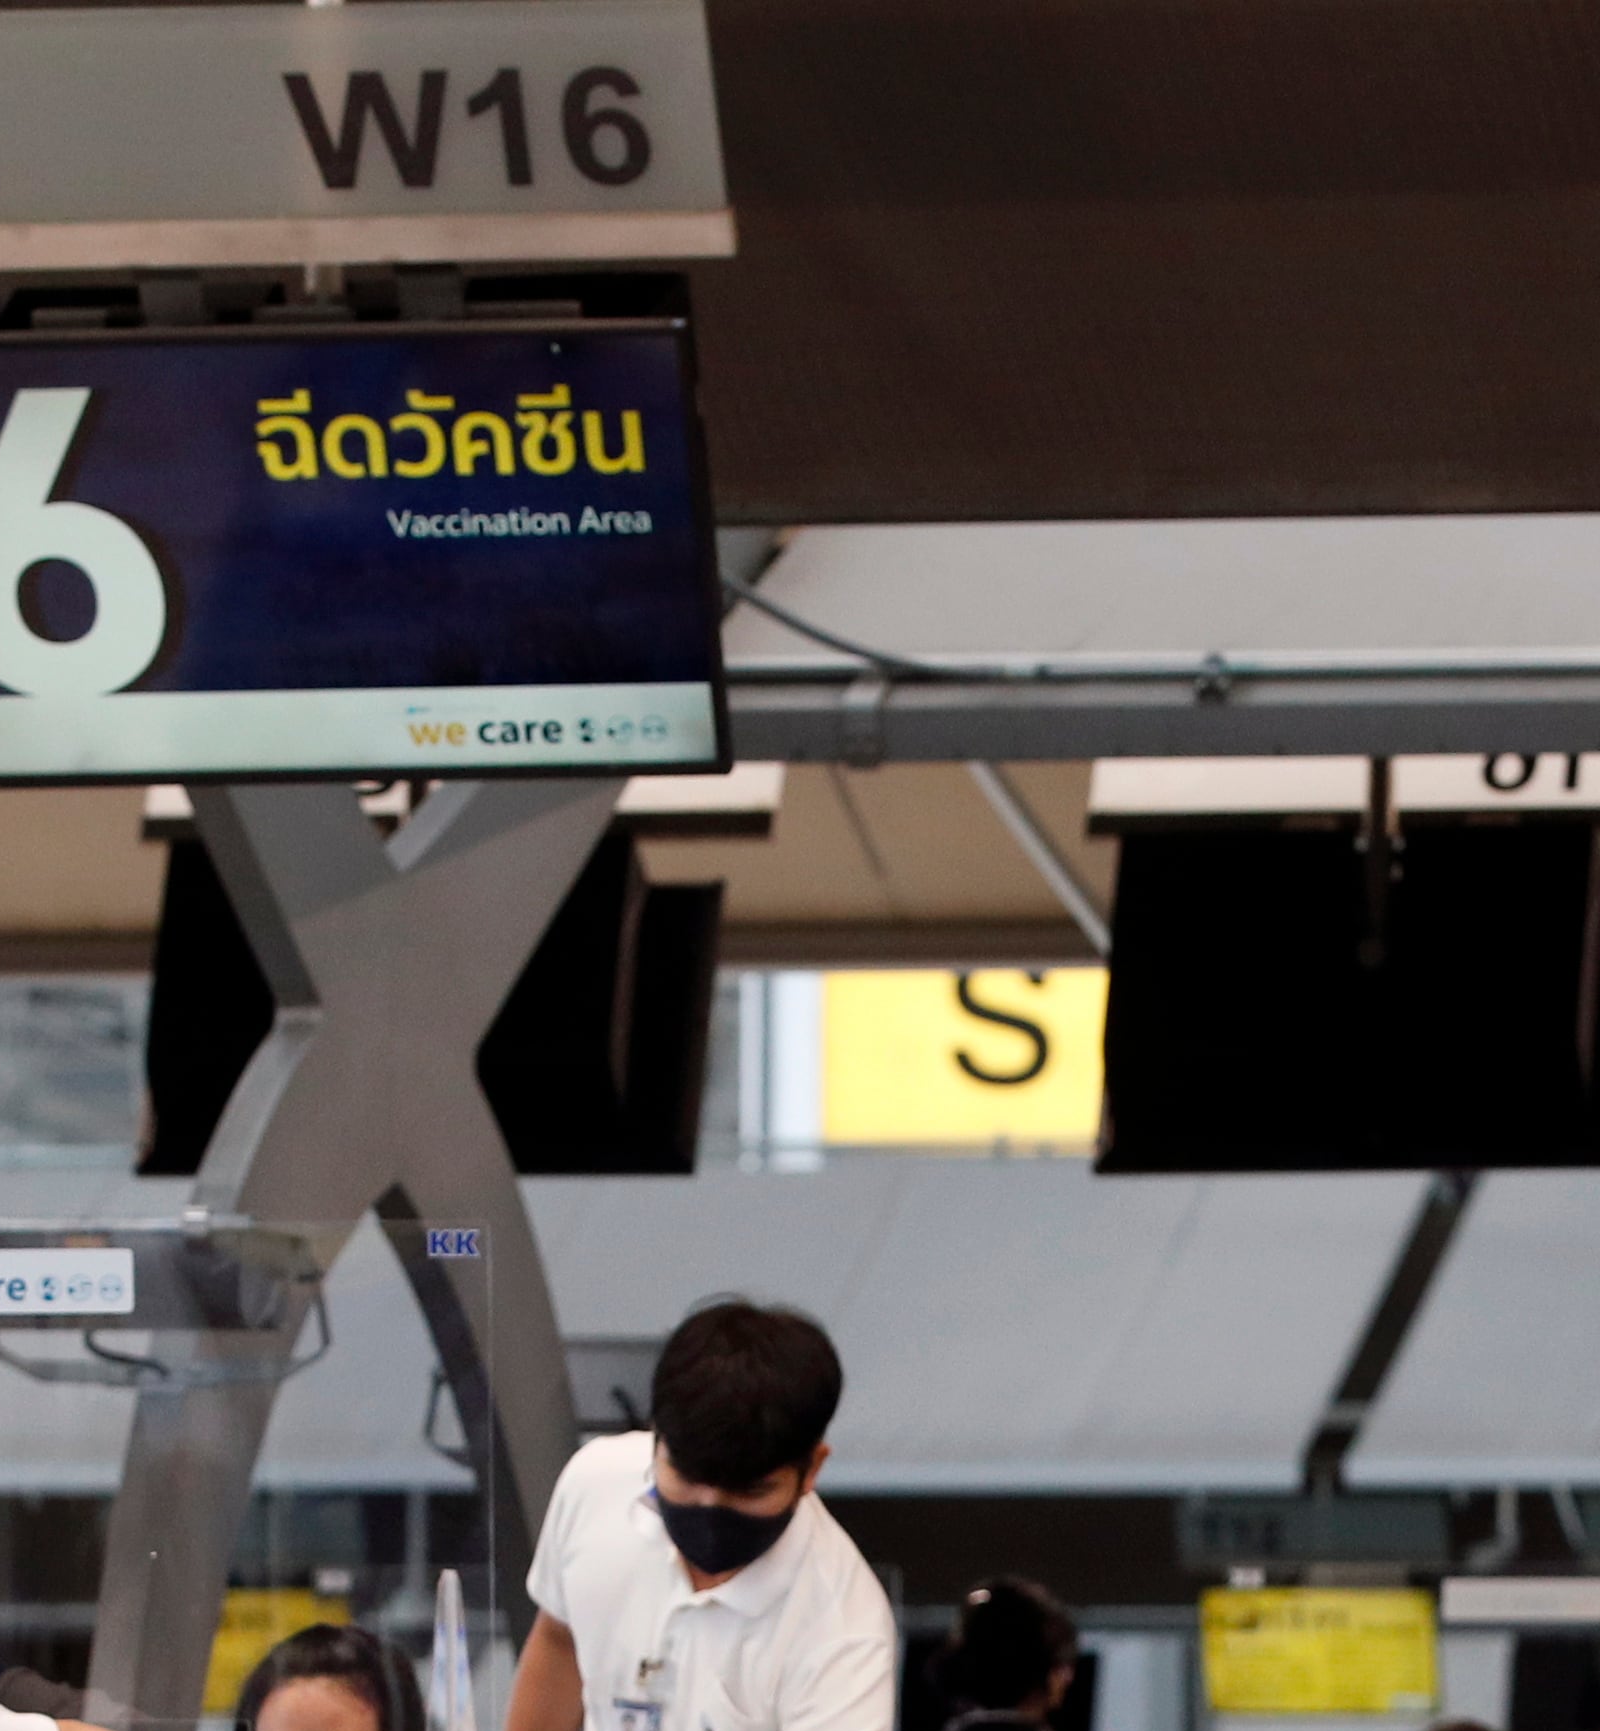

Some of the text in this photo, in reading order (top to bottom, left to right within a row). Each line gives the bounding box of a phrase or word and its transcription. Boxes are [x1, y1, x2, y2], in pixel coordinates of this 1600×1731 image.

[283, 66, 652, 190] W16
[254, 384, 645, 482] ฉีดวัคซีน
[388, 505, 653, 540] Vaccination Area
[409, 714, 564, 748] we care
[956, 968, 1047, 1084] S
[431, 1231, 476, 1254] KK
